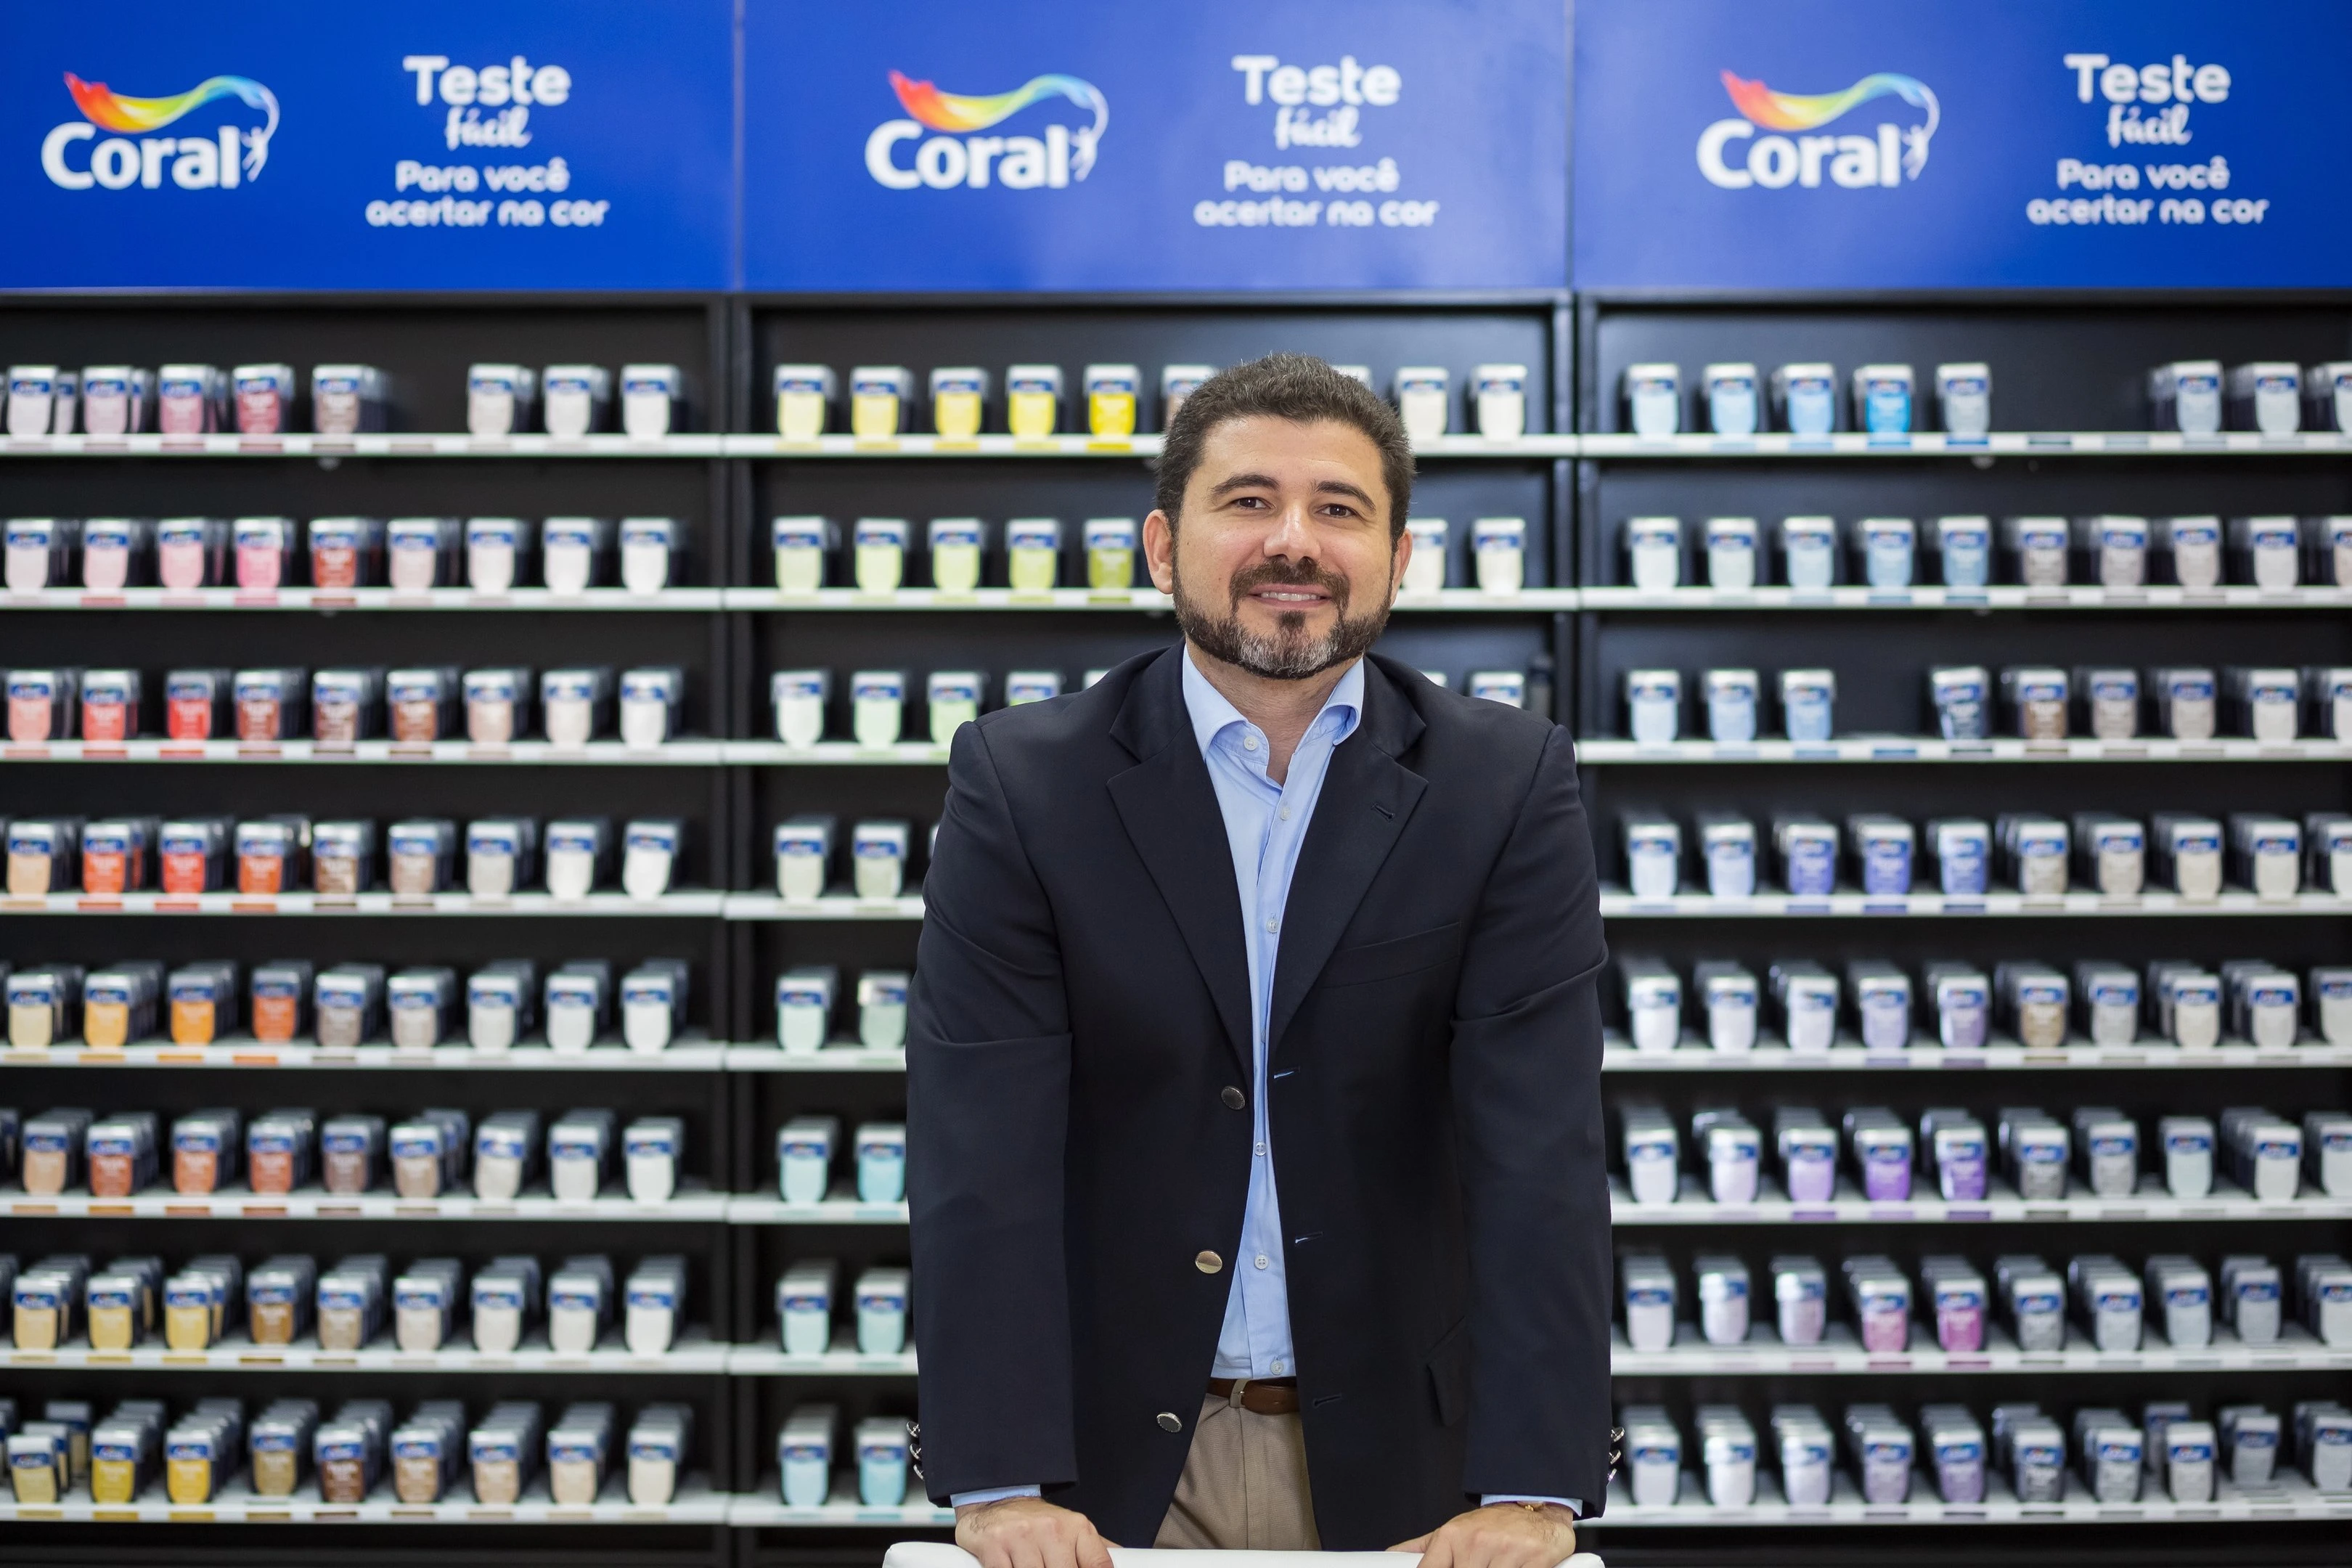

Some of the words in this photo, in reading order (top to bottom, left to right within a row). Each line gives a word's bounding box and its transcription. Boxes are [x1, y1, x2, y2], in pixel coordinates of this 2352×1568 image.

[403, 55, 571, 106] Teste
[1231, 54, 1402, 107] Teste
[2063, 54, 2231, 104] Teste
[445, 105, 531, 150] fácil
[41, 121, 240, 189] Coral
[396, 160, 478, 192] Para
[484, 157, 570, 192] você
[865, 119, 1070, 190] Coral
[1224, 160, 1310, 193] Para
[1312, 156, 1401, 193] você
[1696, 118, 1901, 189] Coral
[2057, 158, 2140, 190] Para
[2144, 155, 2230, 190] você
[365, 196, 493, 226] acertar
[498, 200, 544, 226] na
[550, 200, 610, 226] cor
[1193, 195, 1324, 227] acertar
[1326, 200, 1376, 227] na
[1379, 200, 1440, 227] cor
[2026, 193, 2155, 225] acertar
[2159, 198, 2205, 225] na
[2210, 198, 2271, 225] cor
